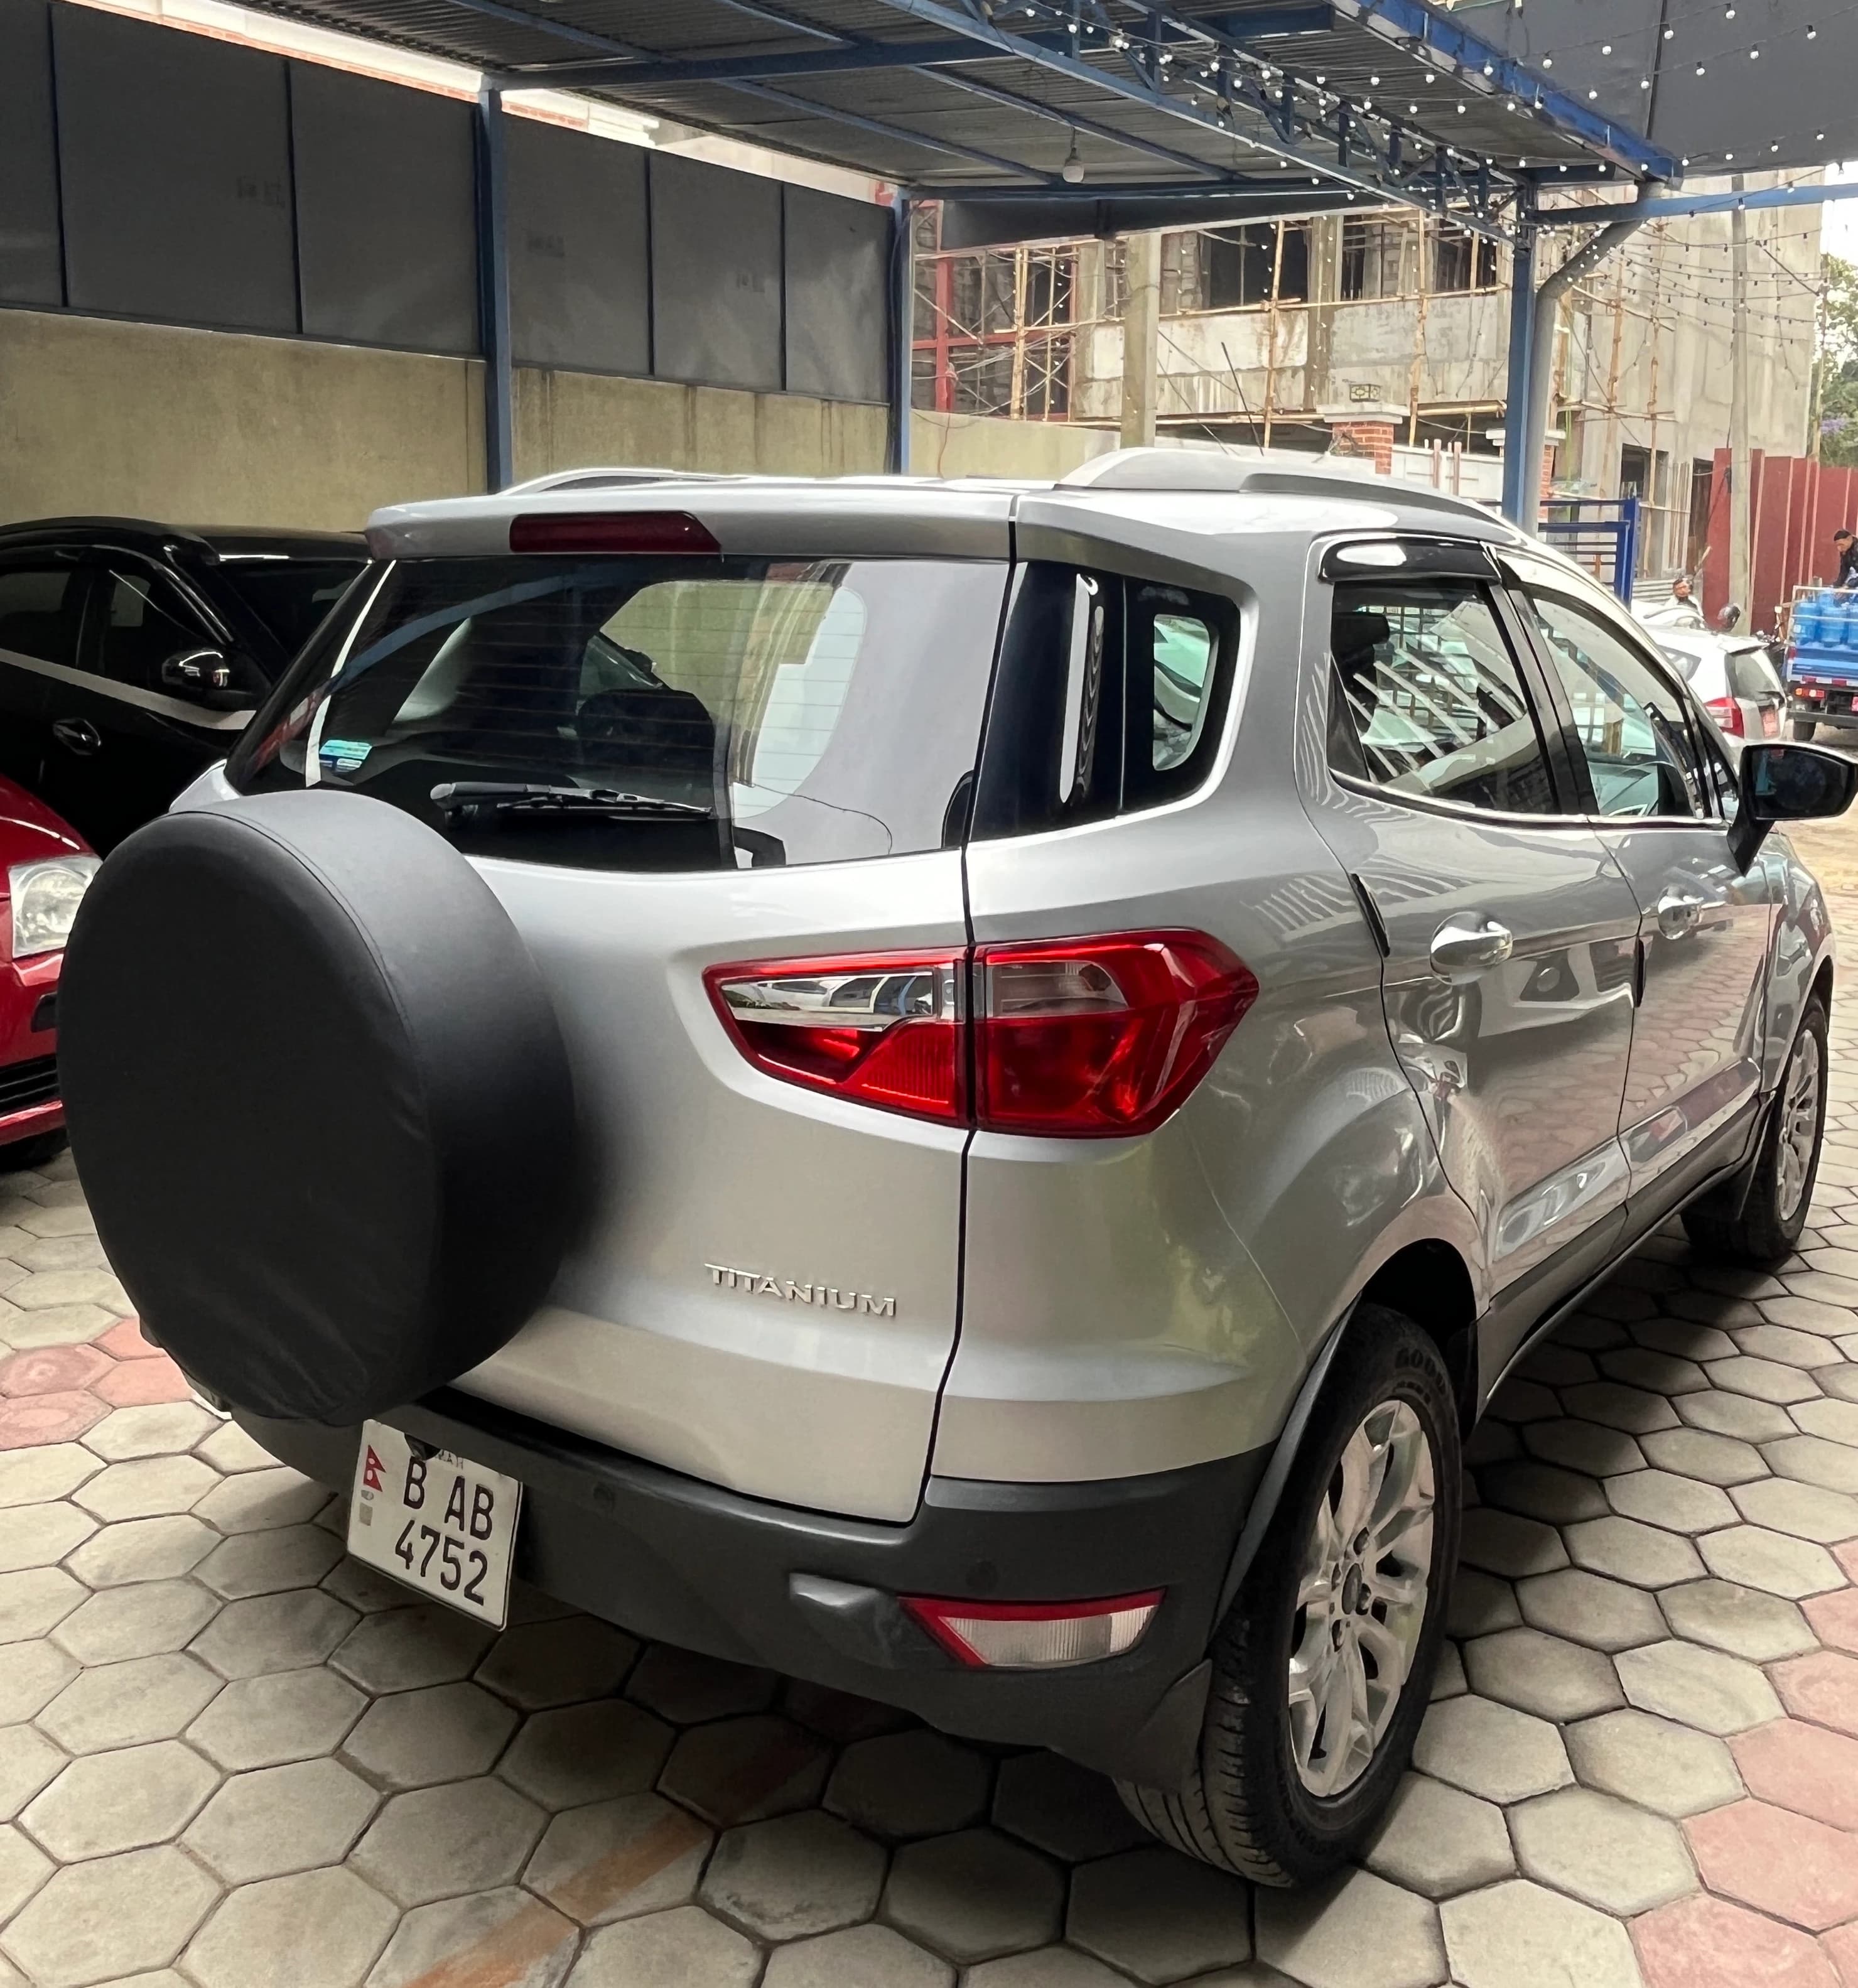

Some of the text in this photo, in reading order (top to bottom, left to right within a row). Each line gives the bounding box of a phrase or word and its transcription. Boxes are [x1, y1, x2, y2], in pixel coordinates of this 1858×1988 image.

[704, 1262, 896, 1317] TITANIUM
[403, 1456, 494, 1540] B AB
[395, 1520, 488, 1606] 4752
